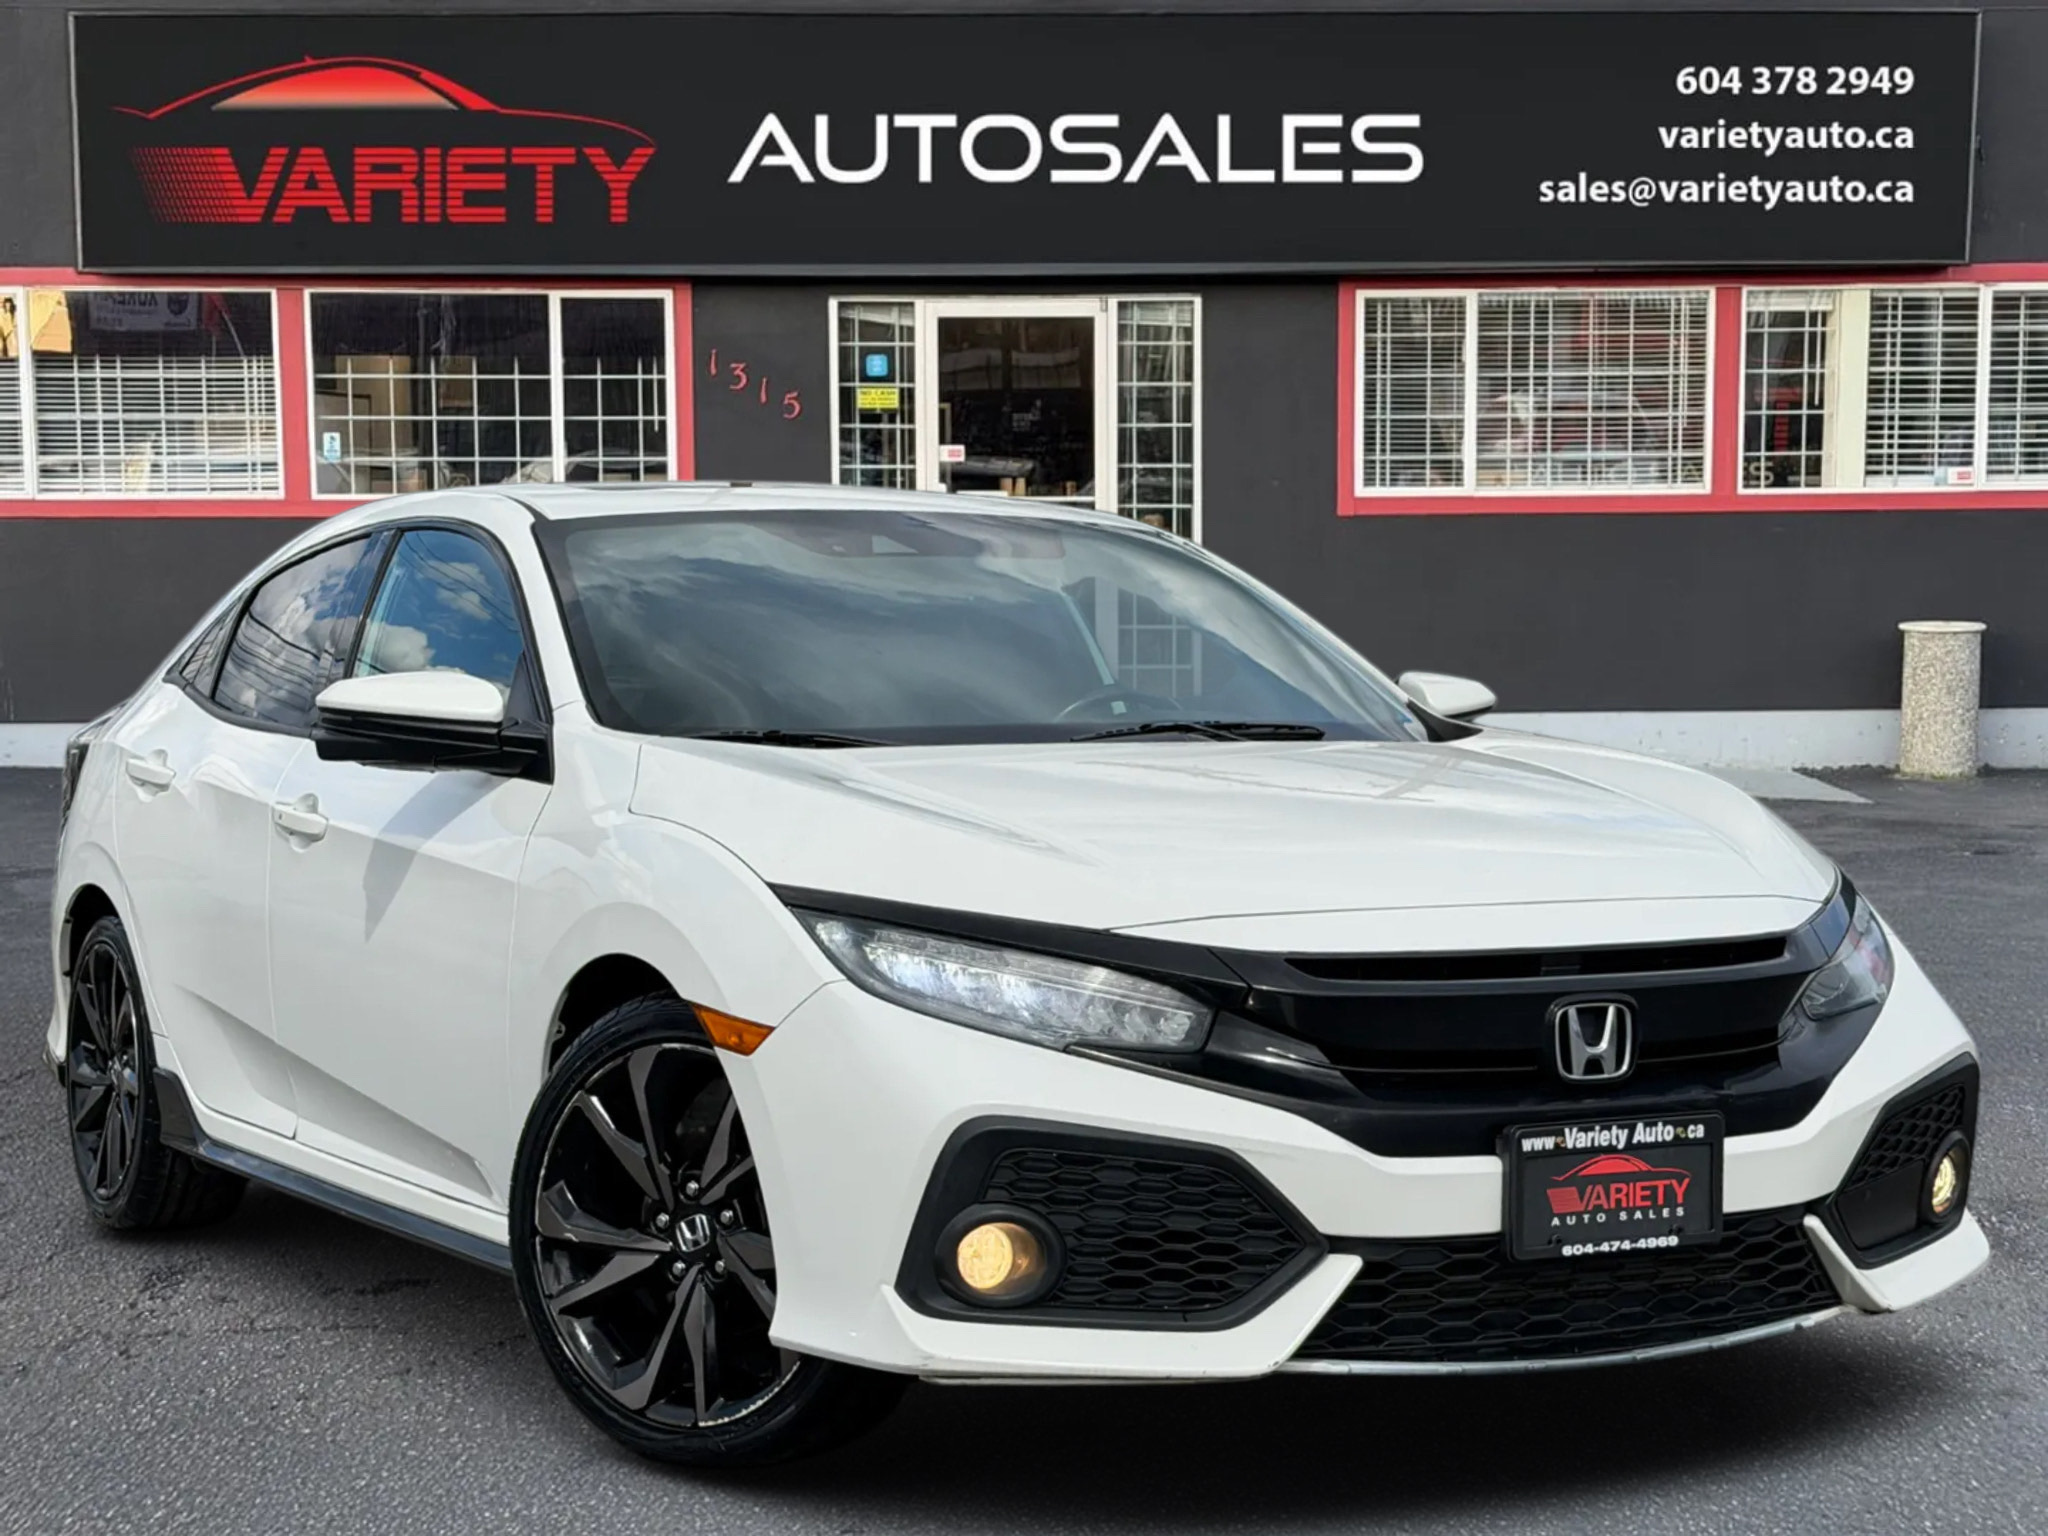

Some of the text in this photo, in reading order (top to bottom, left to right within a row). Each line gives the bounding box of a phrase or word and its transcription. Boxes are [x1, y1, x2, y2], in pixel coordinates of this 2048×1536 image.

[1676, 66, 1915, 95] 604 378 2949
[727, 112, 1424, 184] AUTOSALES
[1658, 118, 1915, 157] varietyauto.ca
[132, 145, 656, 225] VARIETY
[1538, 171, 1915, 211] sales@varietyauto.ca
[709, 348, 802, 420] 1315
[1546, 1178, 1691, 1214] VARIETY
[1551, 1206, 1685, 1227] AUTO SALES
